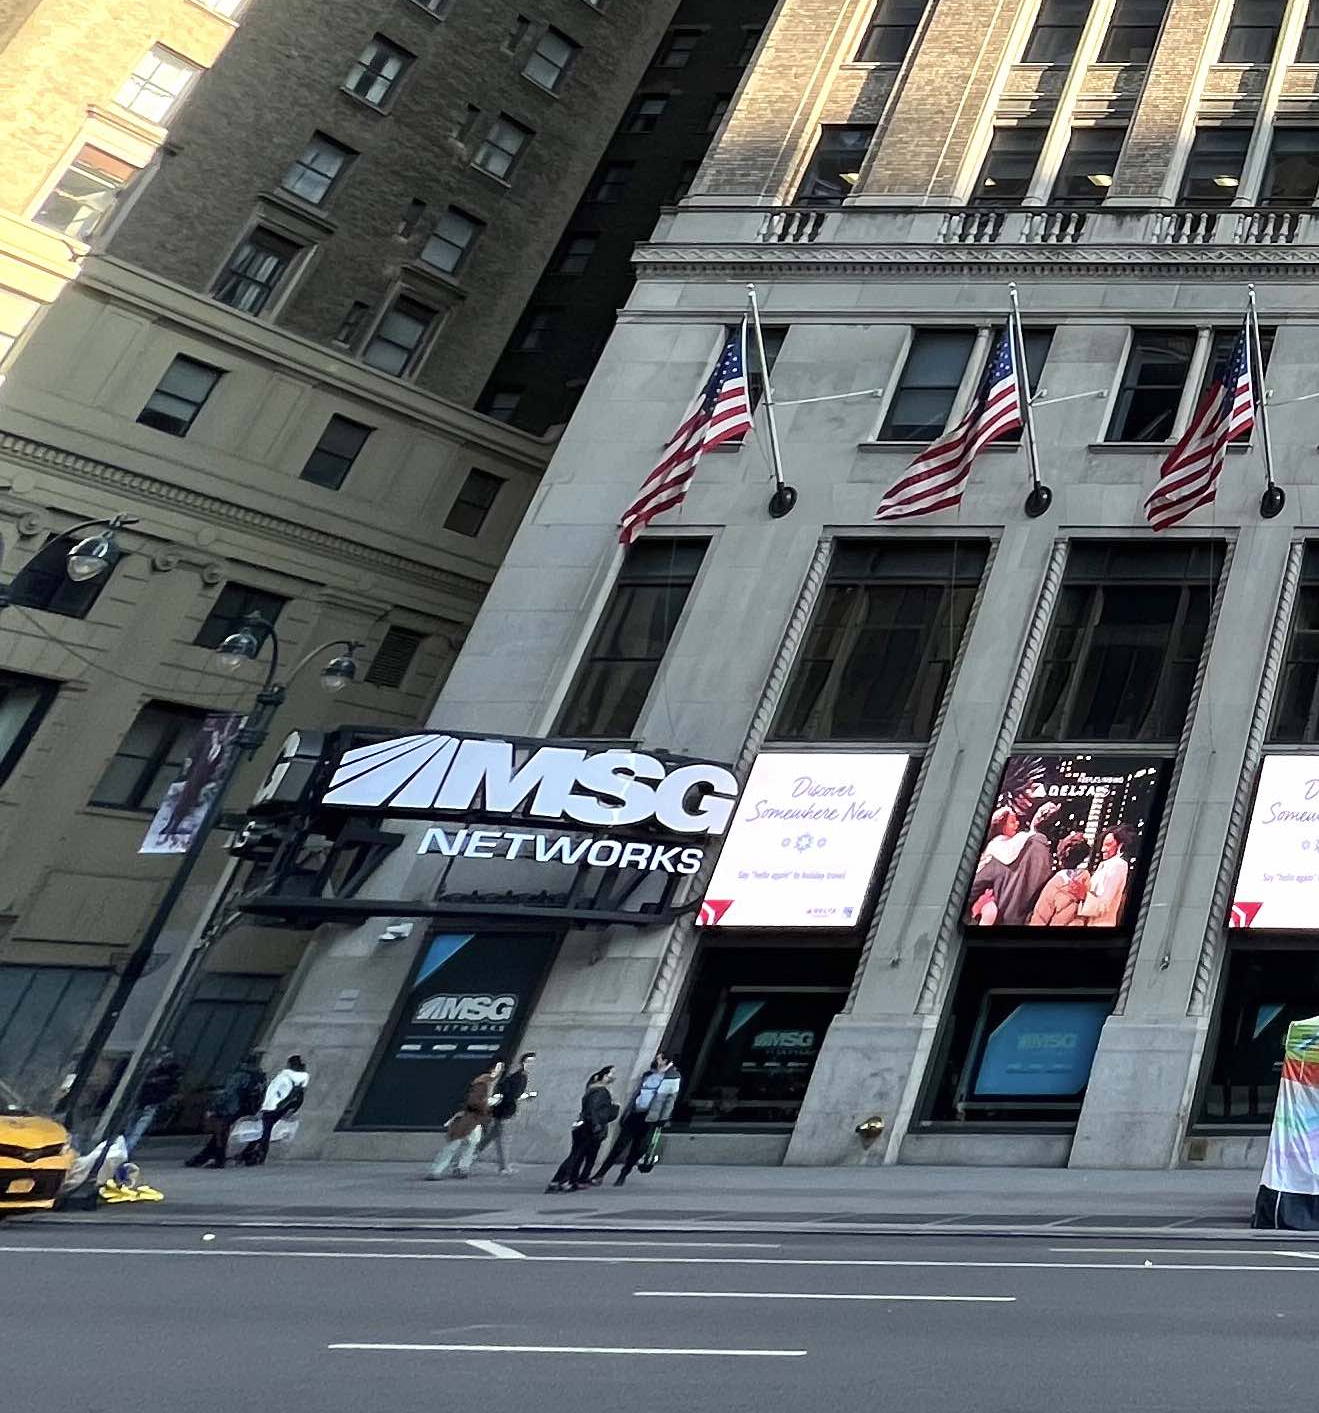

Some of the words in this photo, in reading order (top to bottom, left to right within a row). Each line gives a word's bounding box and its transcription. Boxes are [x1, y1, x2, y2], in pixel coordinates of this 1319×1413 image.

[434, 738, 739, 834] MSG
[791, 776, 855, 798] Discover
[1048, 785, 1096, 797] DELTA
[745, 800, 840, 822] Somewhere
[417, 827, 704, 875] NETWORKS
[443, 996, 515, 1021] MSG
